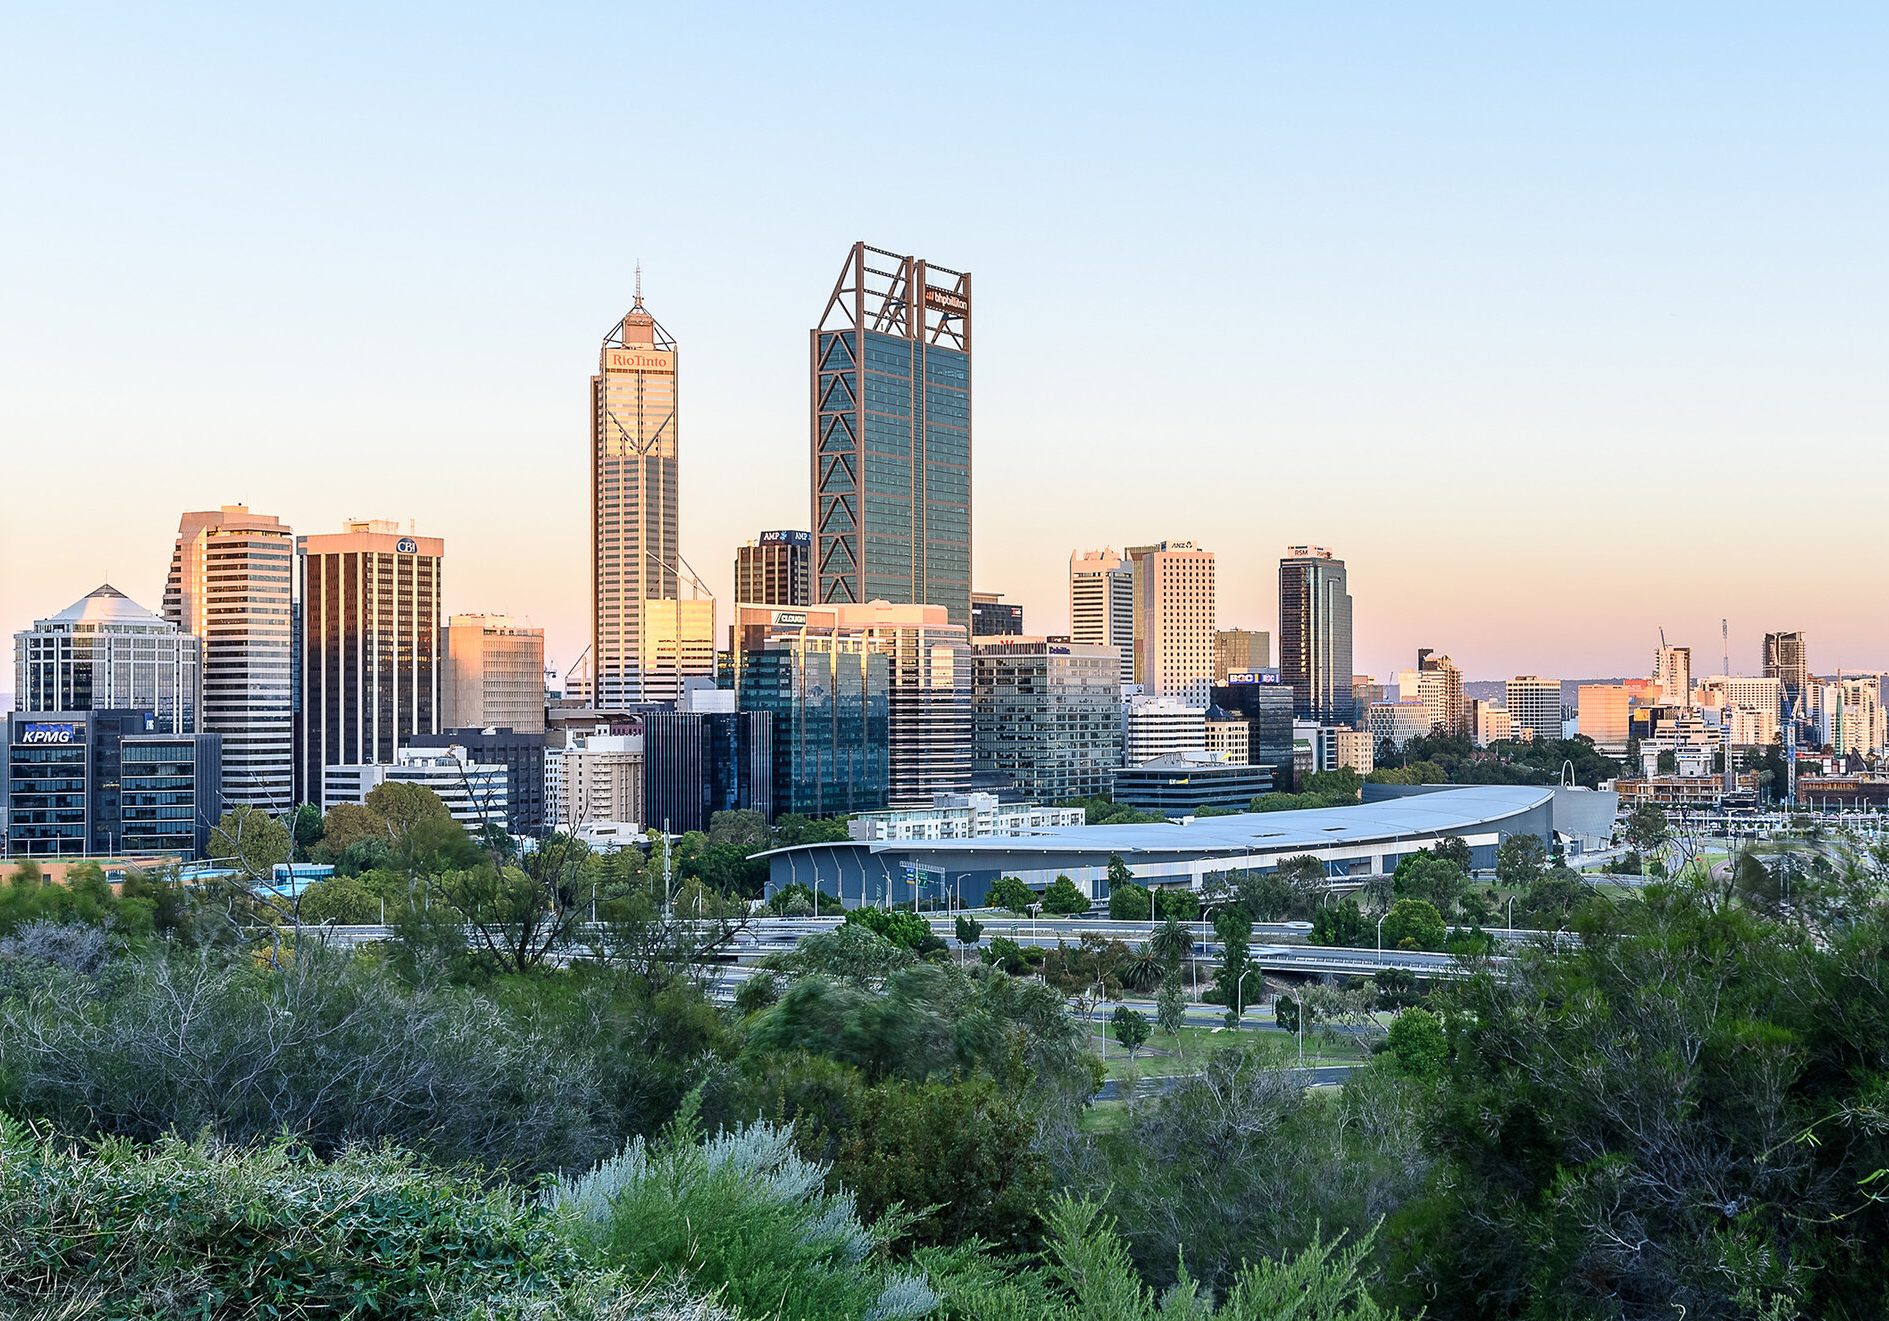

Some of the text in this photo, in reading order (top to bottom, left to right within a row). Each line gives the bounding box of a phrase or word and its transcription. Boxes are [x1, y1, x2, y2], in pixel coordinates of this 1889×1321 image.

[613, 354, 667, 367] RioTinto
[763, 532, 780, 541] AMP
[397, 541, 416, 553] CBI
[22, 731, 70, 743] KPMG
